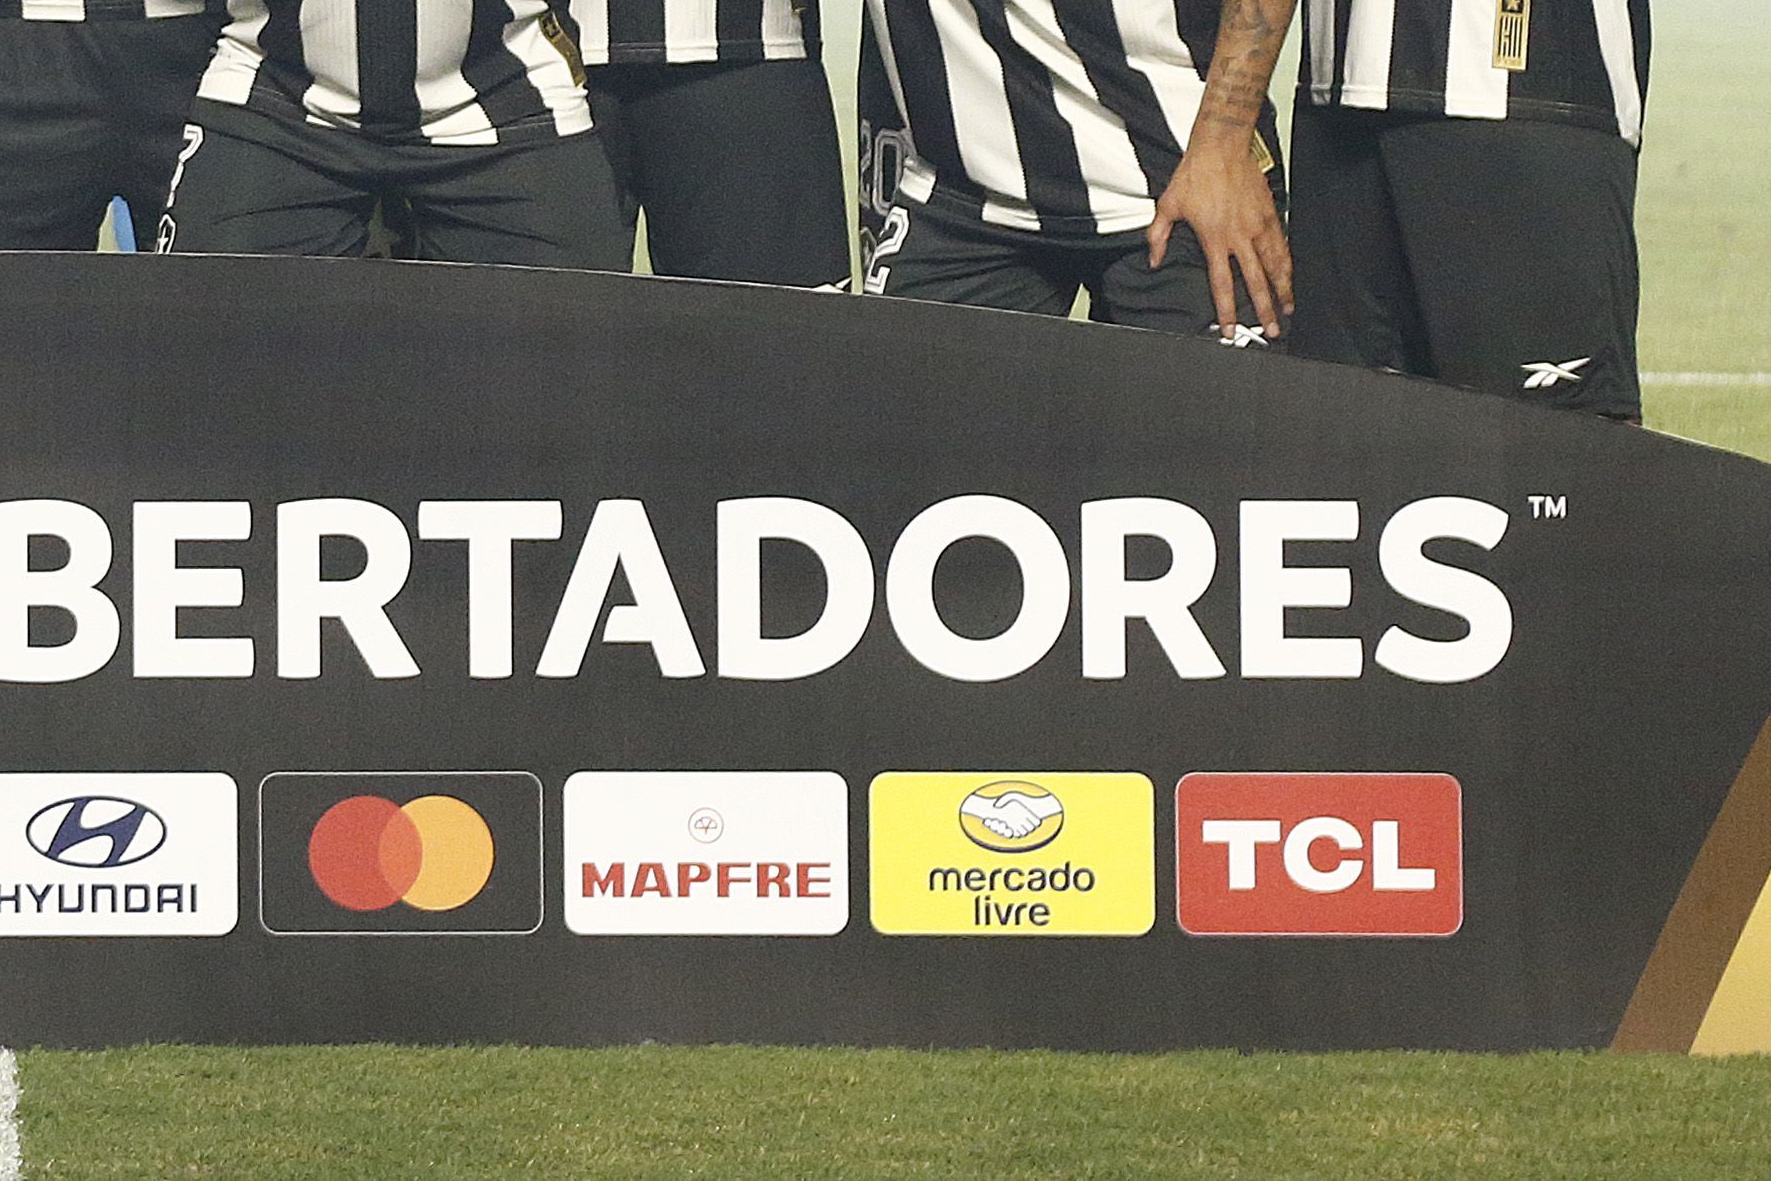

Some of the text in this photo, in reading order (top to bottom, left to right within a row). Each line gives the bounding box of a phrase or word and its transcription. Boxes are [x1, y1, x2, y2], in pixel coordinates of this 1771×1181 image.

[1202, 816, 1435, 892] TCL
[583, 862, 829, 898] MAPFRE
[929, 861, 1095, 892] mercado
[974, 895, 1050, 926] livre
